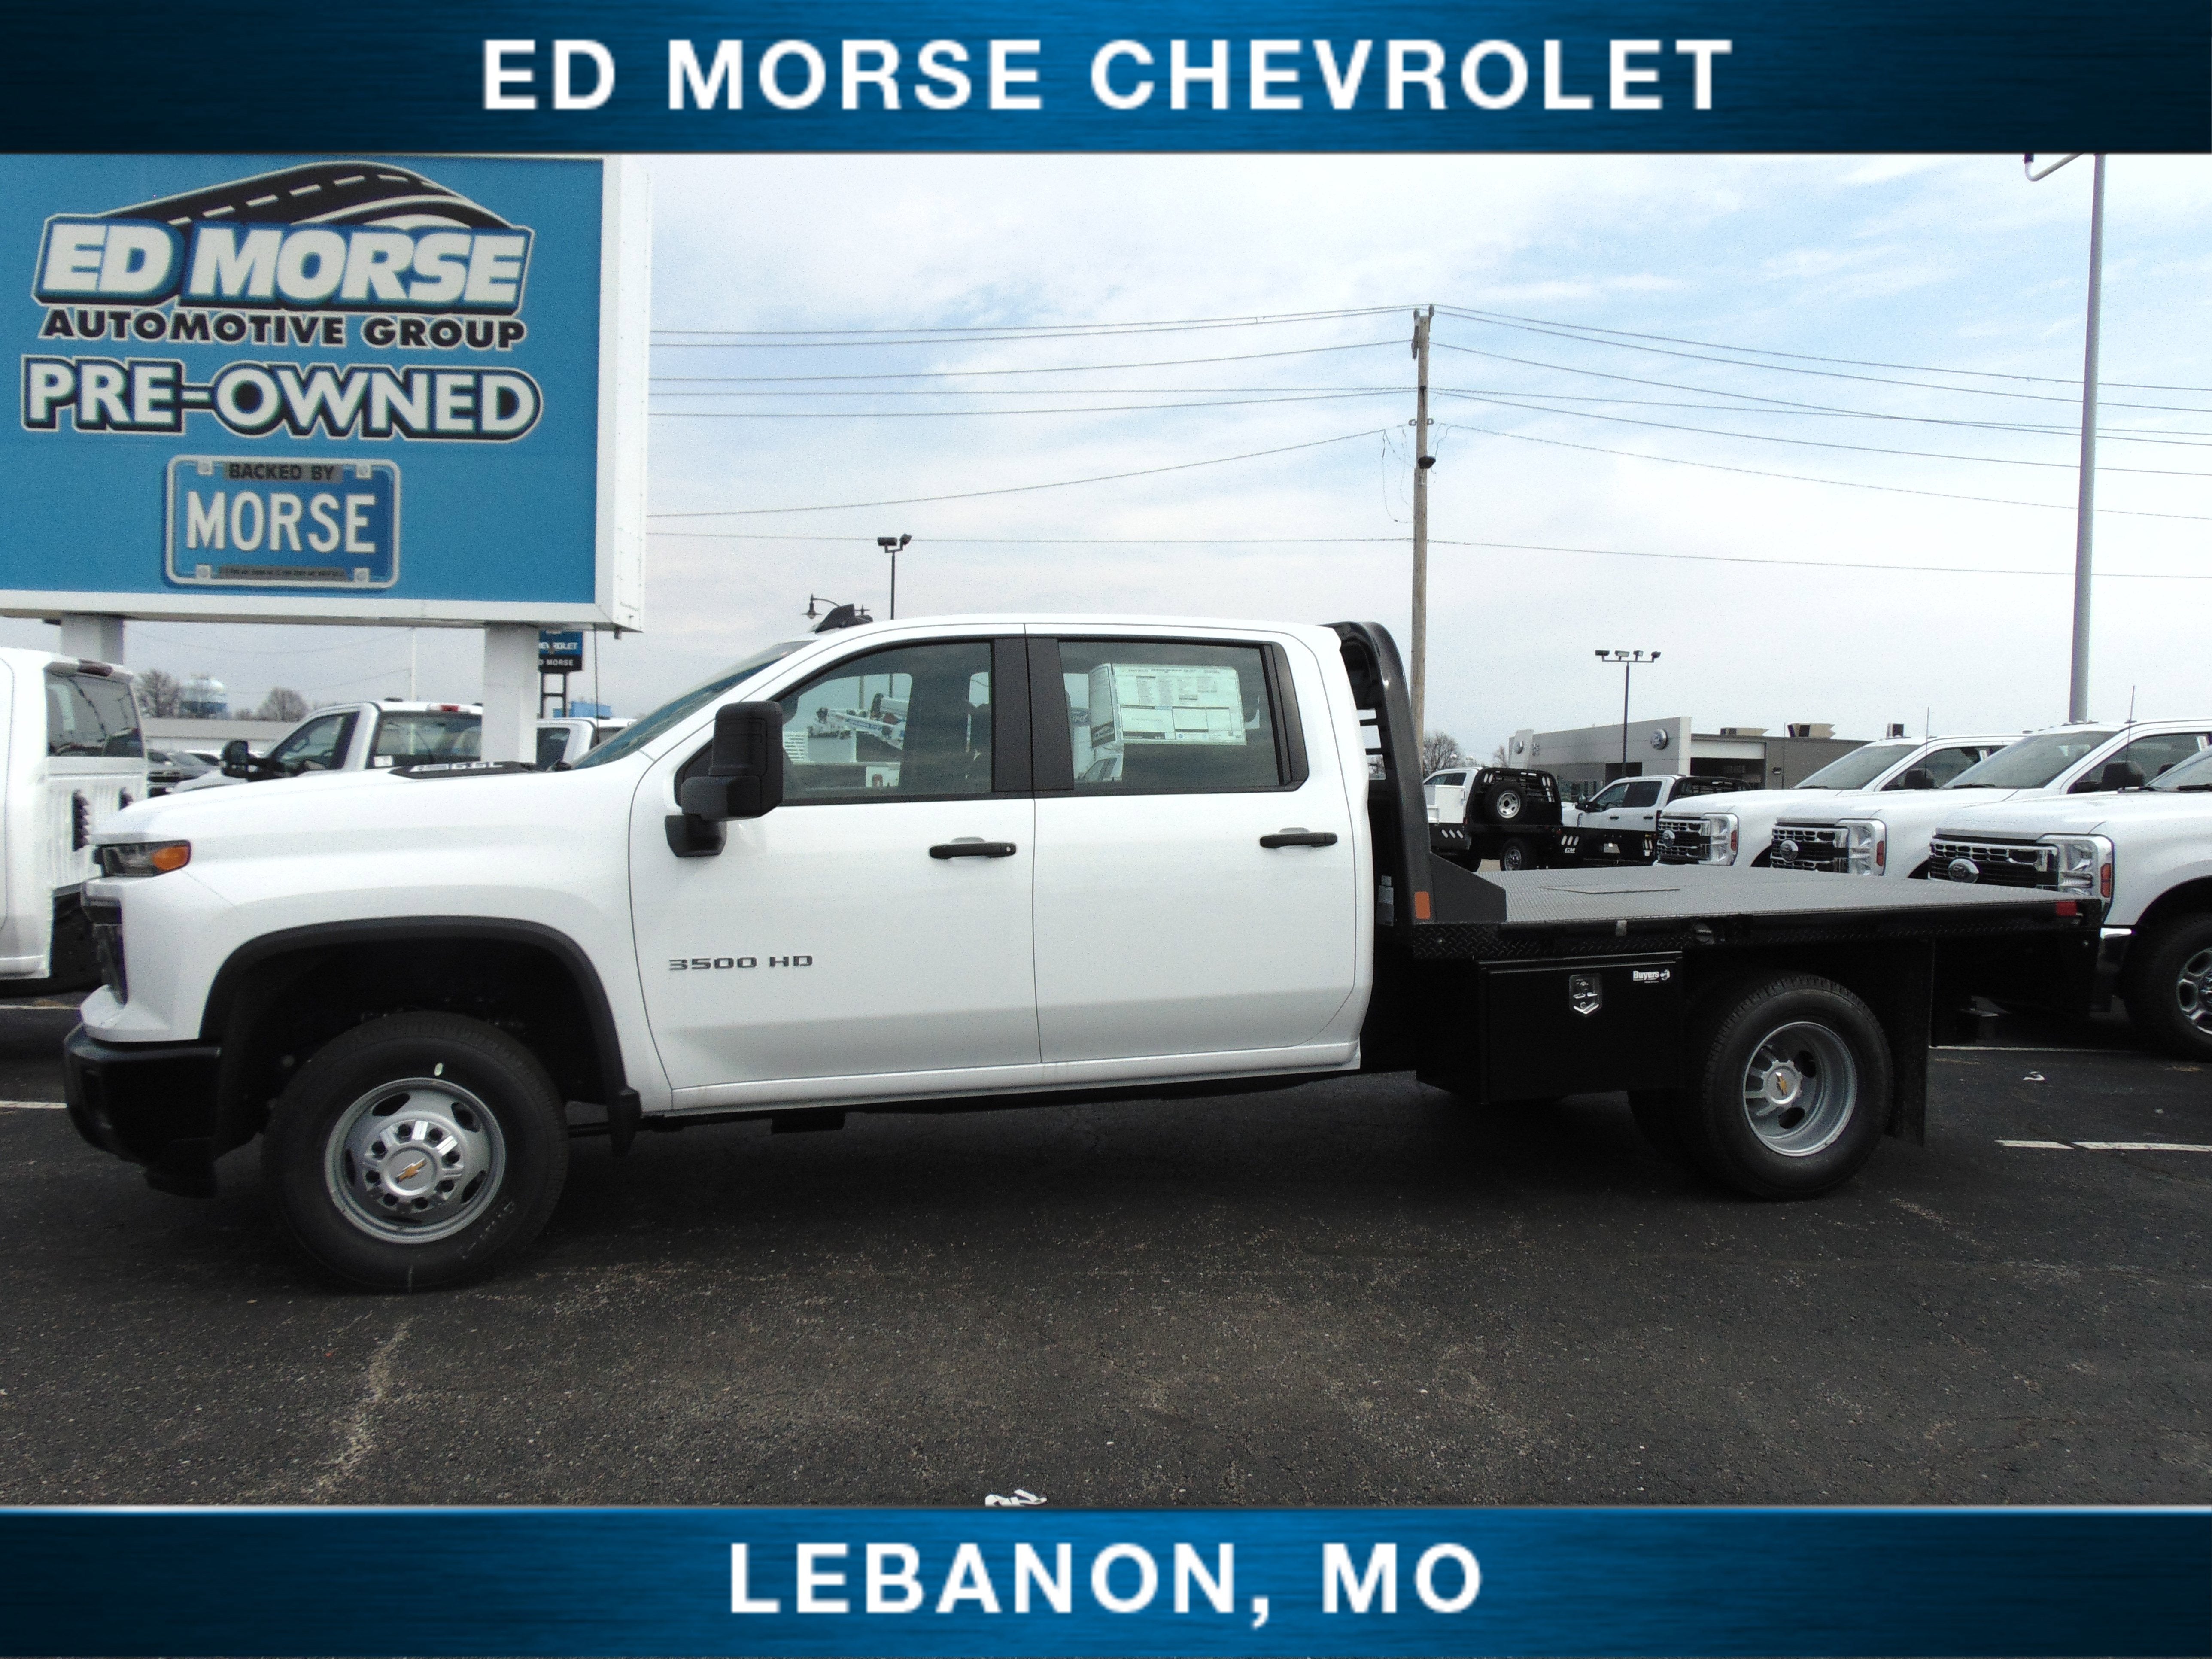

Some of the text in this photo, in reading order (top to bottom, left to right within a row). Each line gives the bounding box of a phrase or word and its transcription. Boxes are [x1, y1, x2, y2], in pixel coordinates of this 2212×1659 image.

[44, 224, 525, 302] ED MORSE
[43, 310, 525, 348] AUTOMOTIVE GROUP
[30, 364, 534, 431] PRE-OWNED
[228, 463, 335, 481] BACKED BY
[187, 491, 375, 552] MORSE
[669, 955, 813, 971] 3500 HD
[1633, 970, 1659, 981] Buyers
